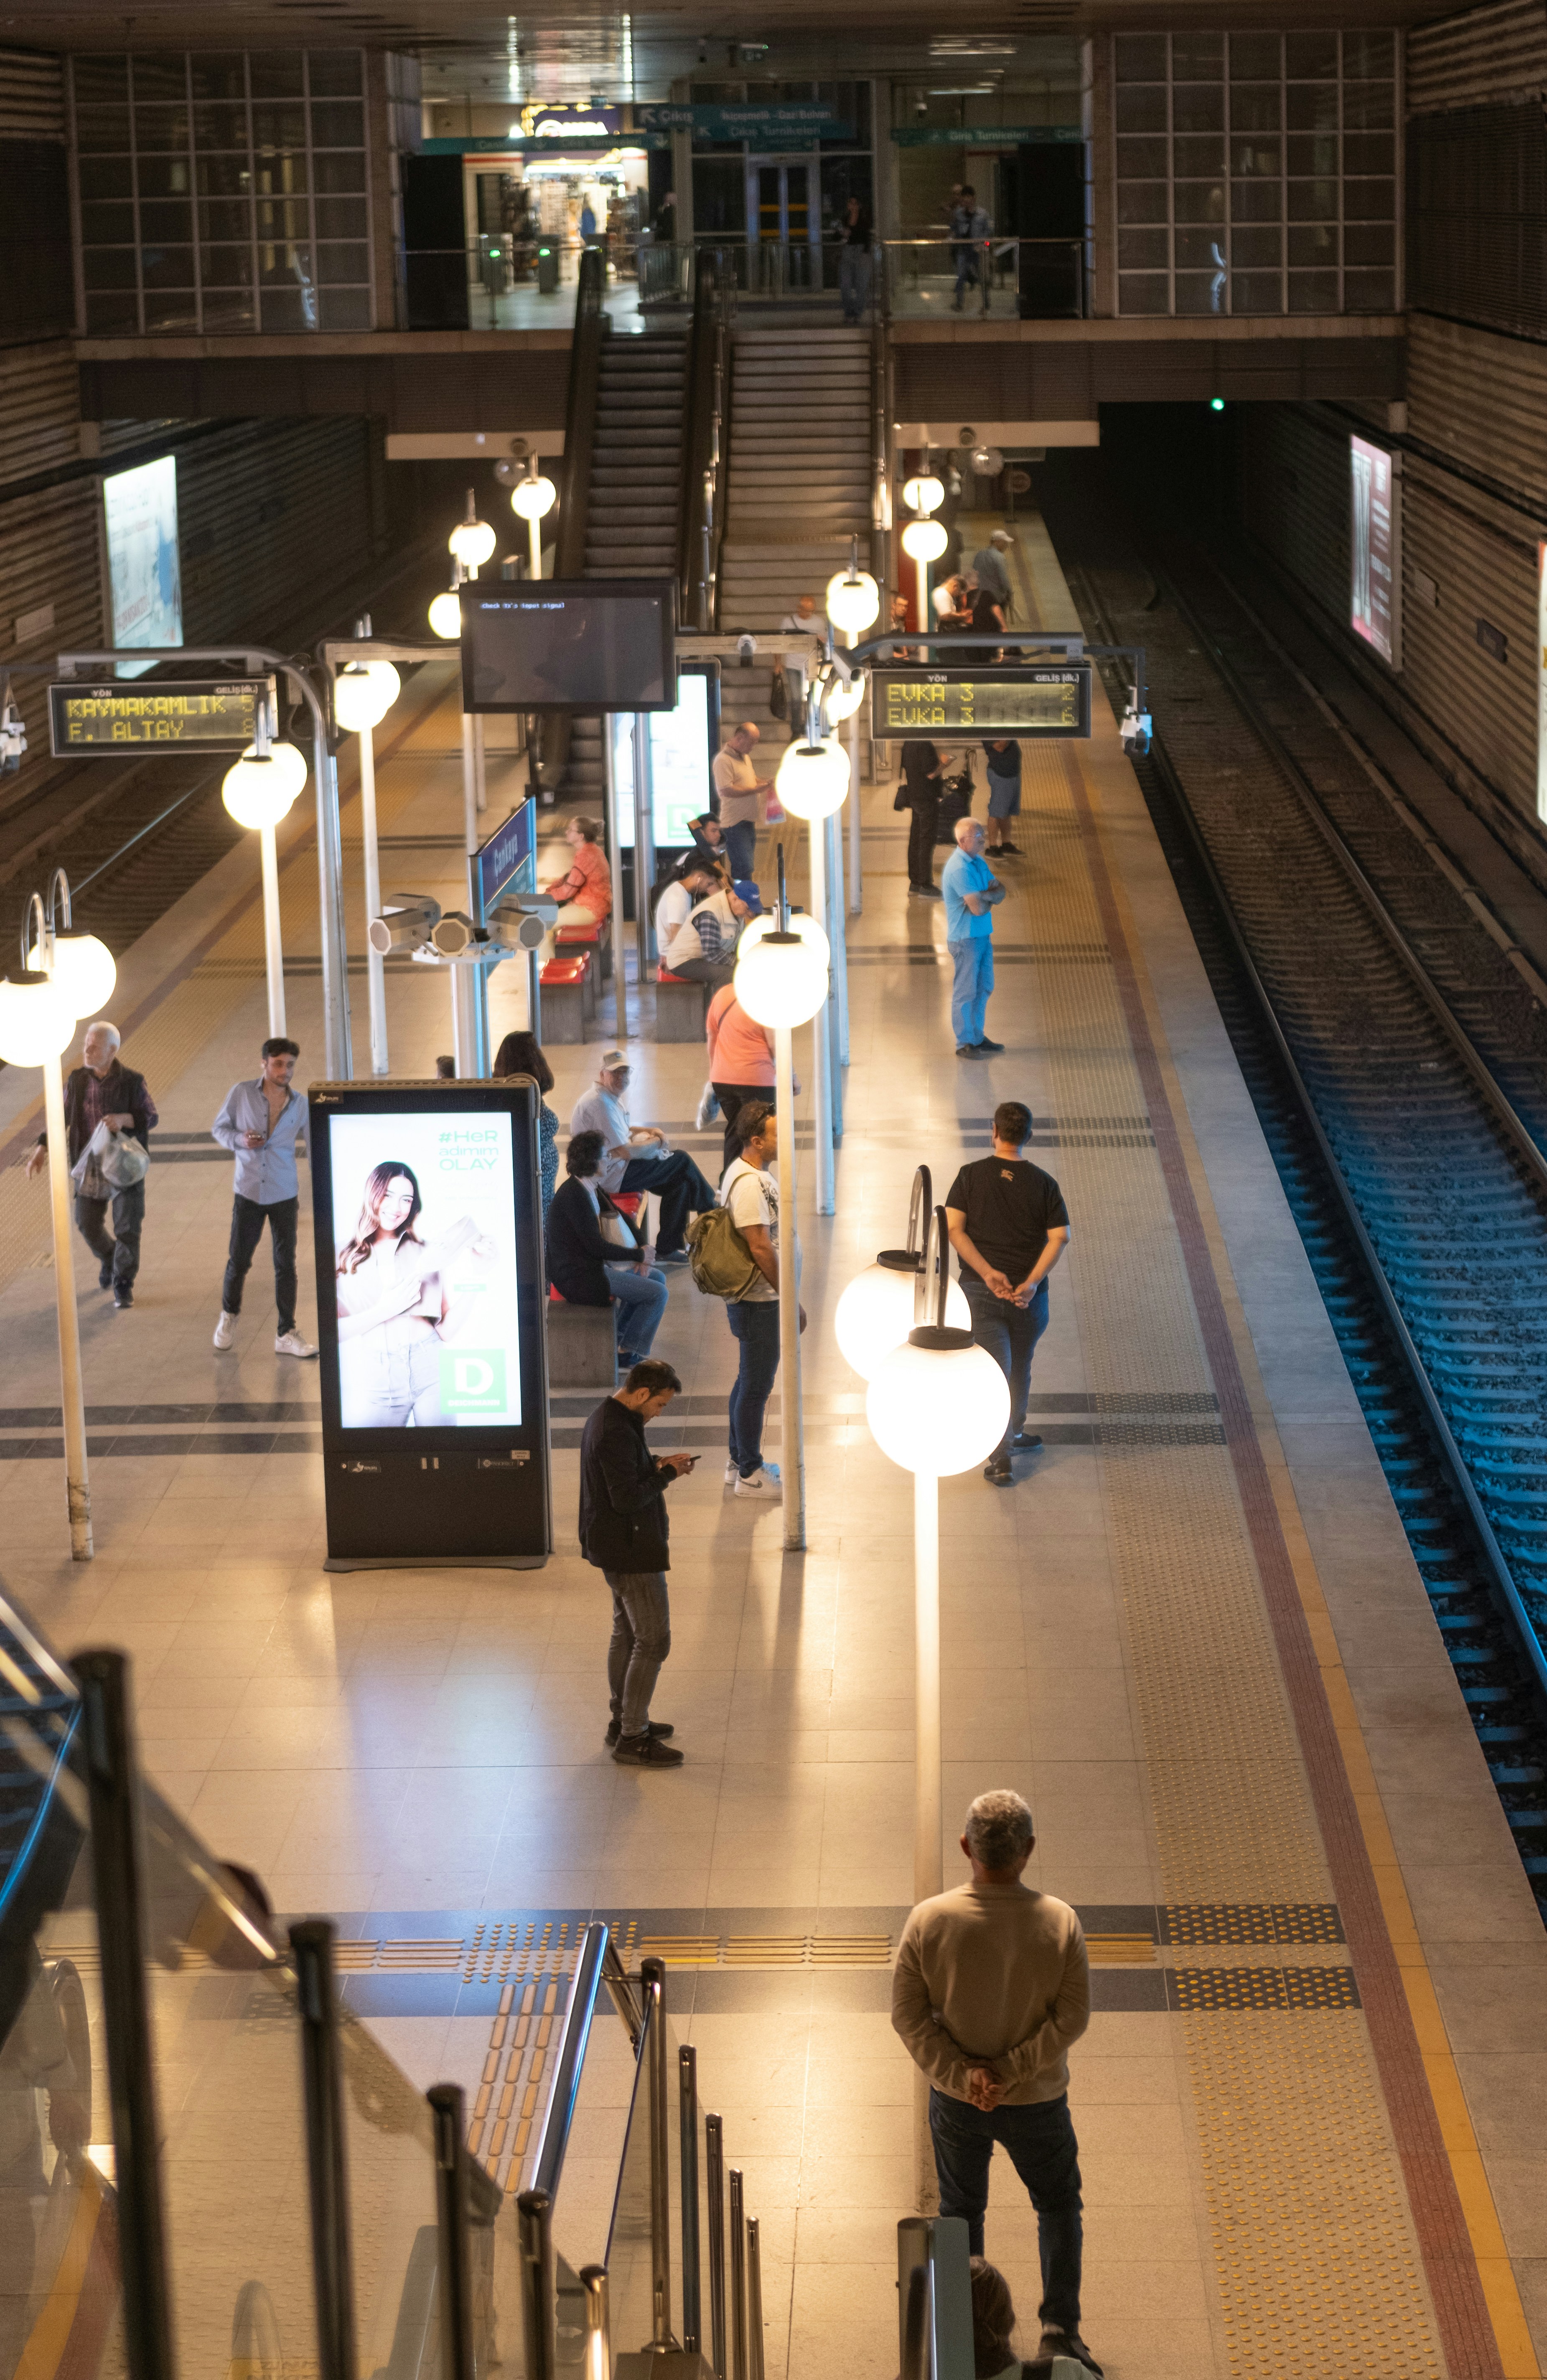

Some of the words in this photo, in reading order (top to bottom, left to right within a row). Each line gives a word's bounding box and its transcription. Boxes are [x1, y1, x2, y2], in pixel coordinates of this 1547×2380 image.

[928, 674, 948, 682] YÖN
[1035, 673, 1061, 683] GELİŞ
[91, 688, 112, 698] YÖN
[888, 684, 945, 702] EVKA
[960, 683, 974, 702] 3
[1061, 684, 1075, 701] 2
[66, 695, 226, 718] KAYMAKAMLIK
[241, 694, 255, 713] 5
[888, 707, 945, 725] EVKA
[960, 707, 974, 725] 3
[1061, 706, 1075, 725] 6
[68, 722, 94, 742] F.
[111, 719, 184, 740] ALTAY
[494, 834, 518, 882] Çankaya
[439, 1158, 498, 1171] OLAY
[454, 1358, 494, 1395] D
